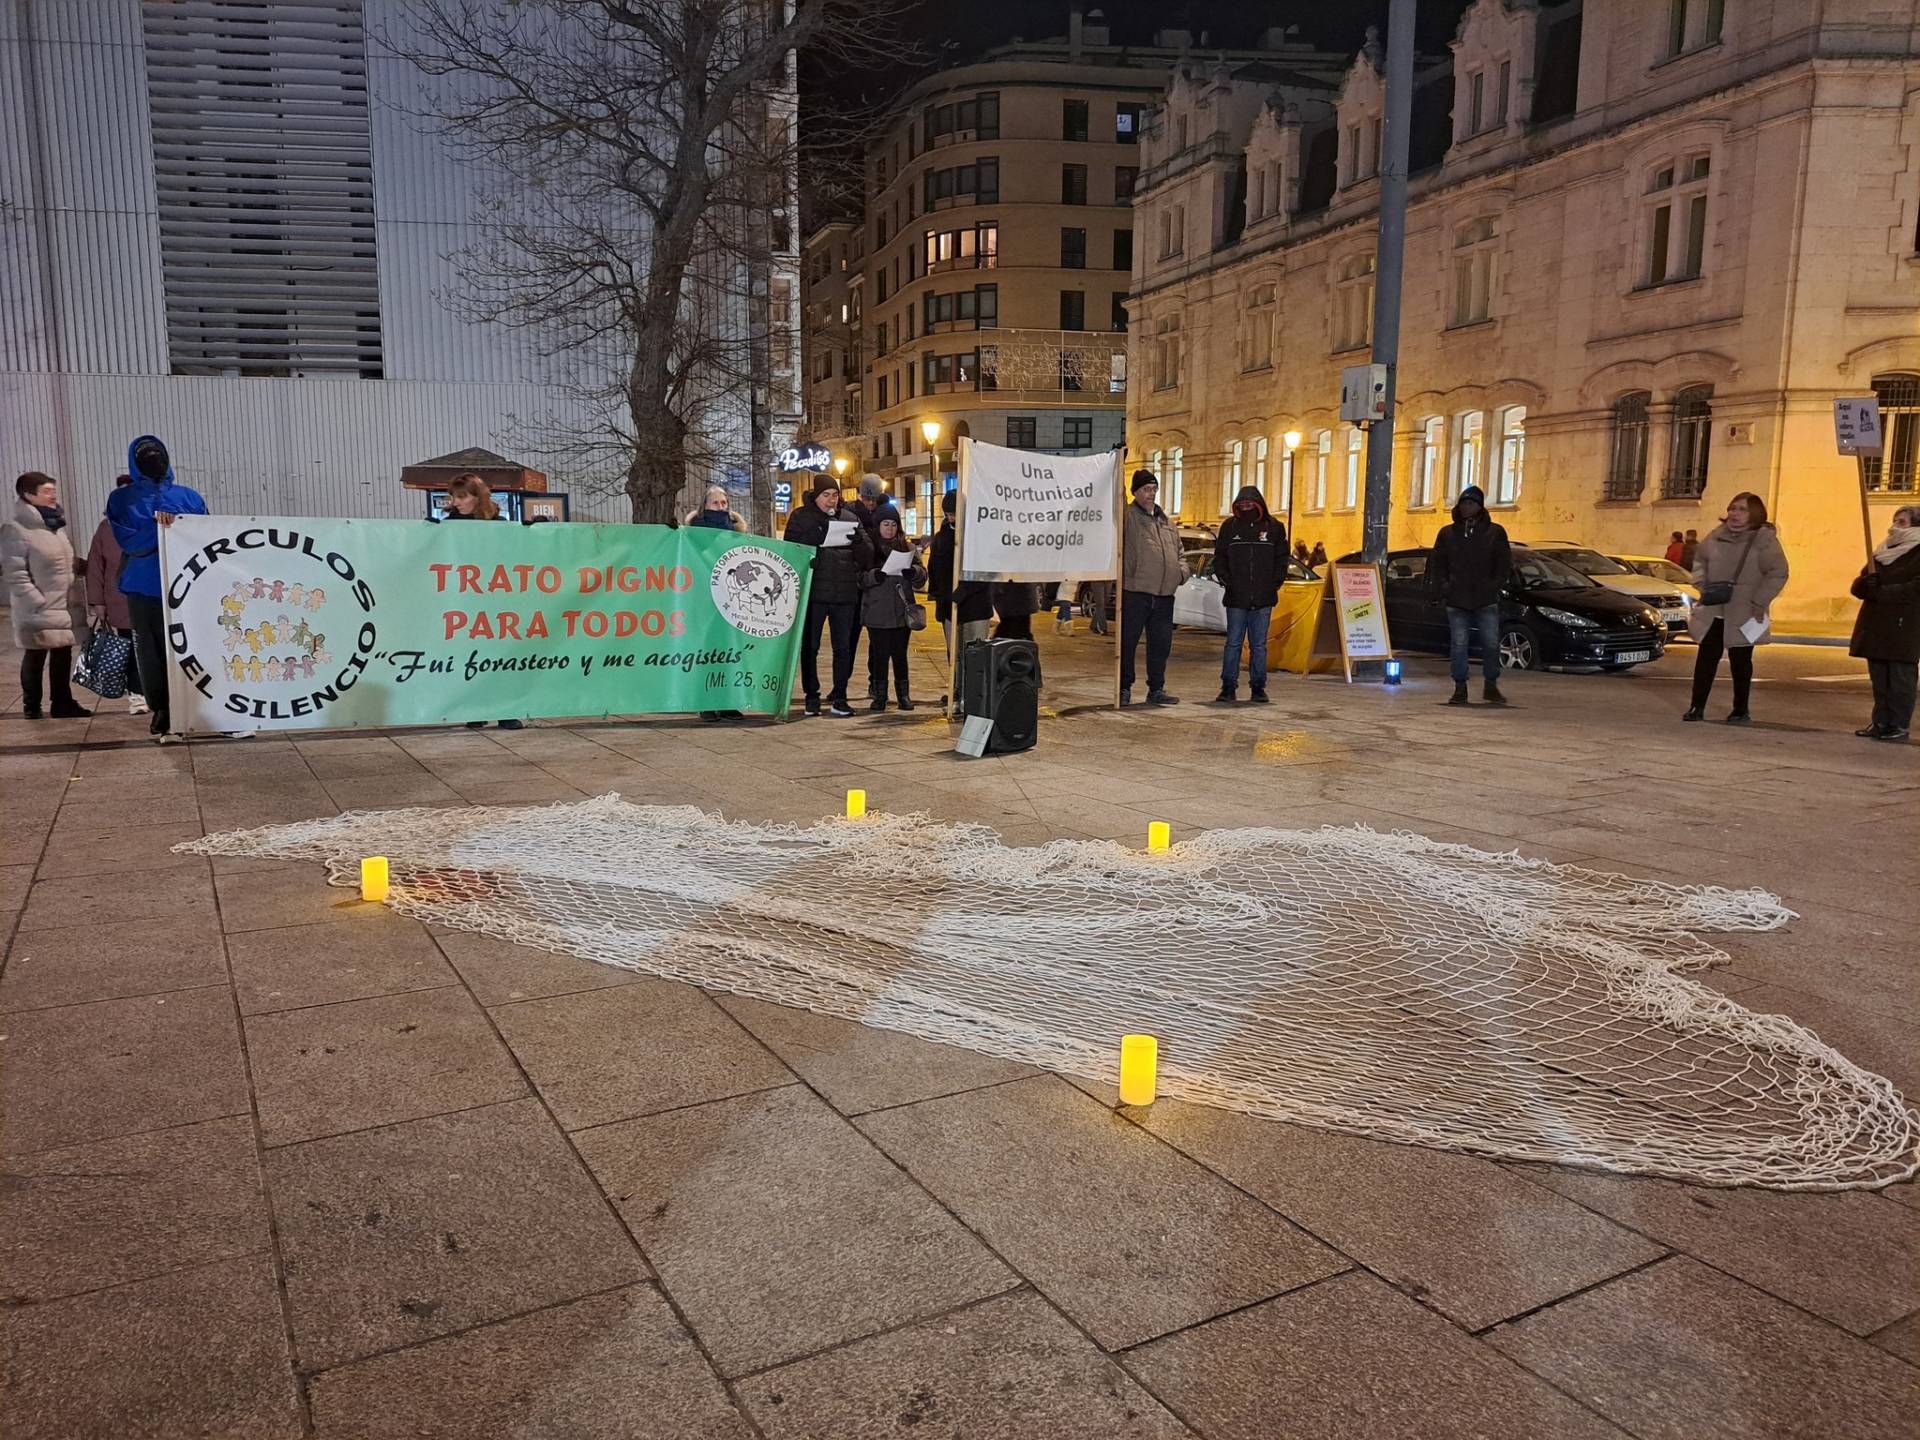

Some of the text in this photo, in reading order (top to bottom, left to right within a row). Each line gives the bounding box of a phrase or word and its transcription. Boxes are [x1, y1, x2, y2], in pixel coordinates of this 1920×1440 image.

[779, 448, 830, 471] Pecaditos
[1021, 462, 1054, 480] Una
[995, 482, 1094, 502] oportunidad
[533, 504, 555, 516] BIEN
[977, 505, 1103, 524] para crear redes
[1001, 528, 1084, 550] de acogida
[168, 528, 376, 612] CIRCULOS
[711, 550, 738, 586] PASTORAL
[742, 546, 760, 555] CON
[429, 563, 693, 595] TRATO DIGNO
[442, 609, 687, 641] PARA TODOS
[736, 621, 780, 637] BURGOS
[169, 621, 377, 719] DEL SILENCIO
[464, 649, 570, 681] forastero
[581, 655, 593, 676] y
[603, 652, 635, 668] me
[705, 670, 782, 696] (Mt. 25, 38)
